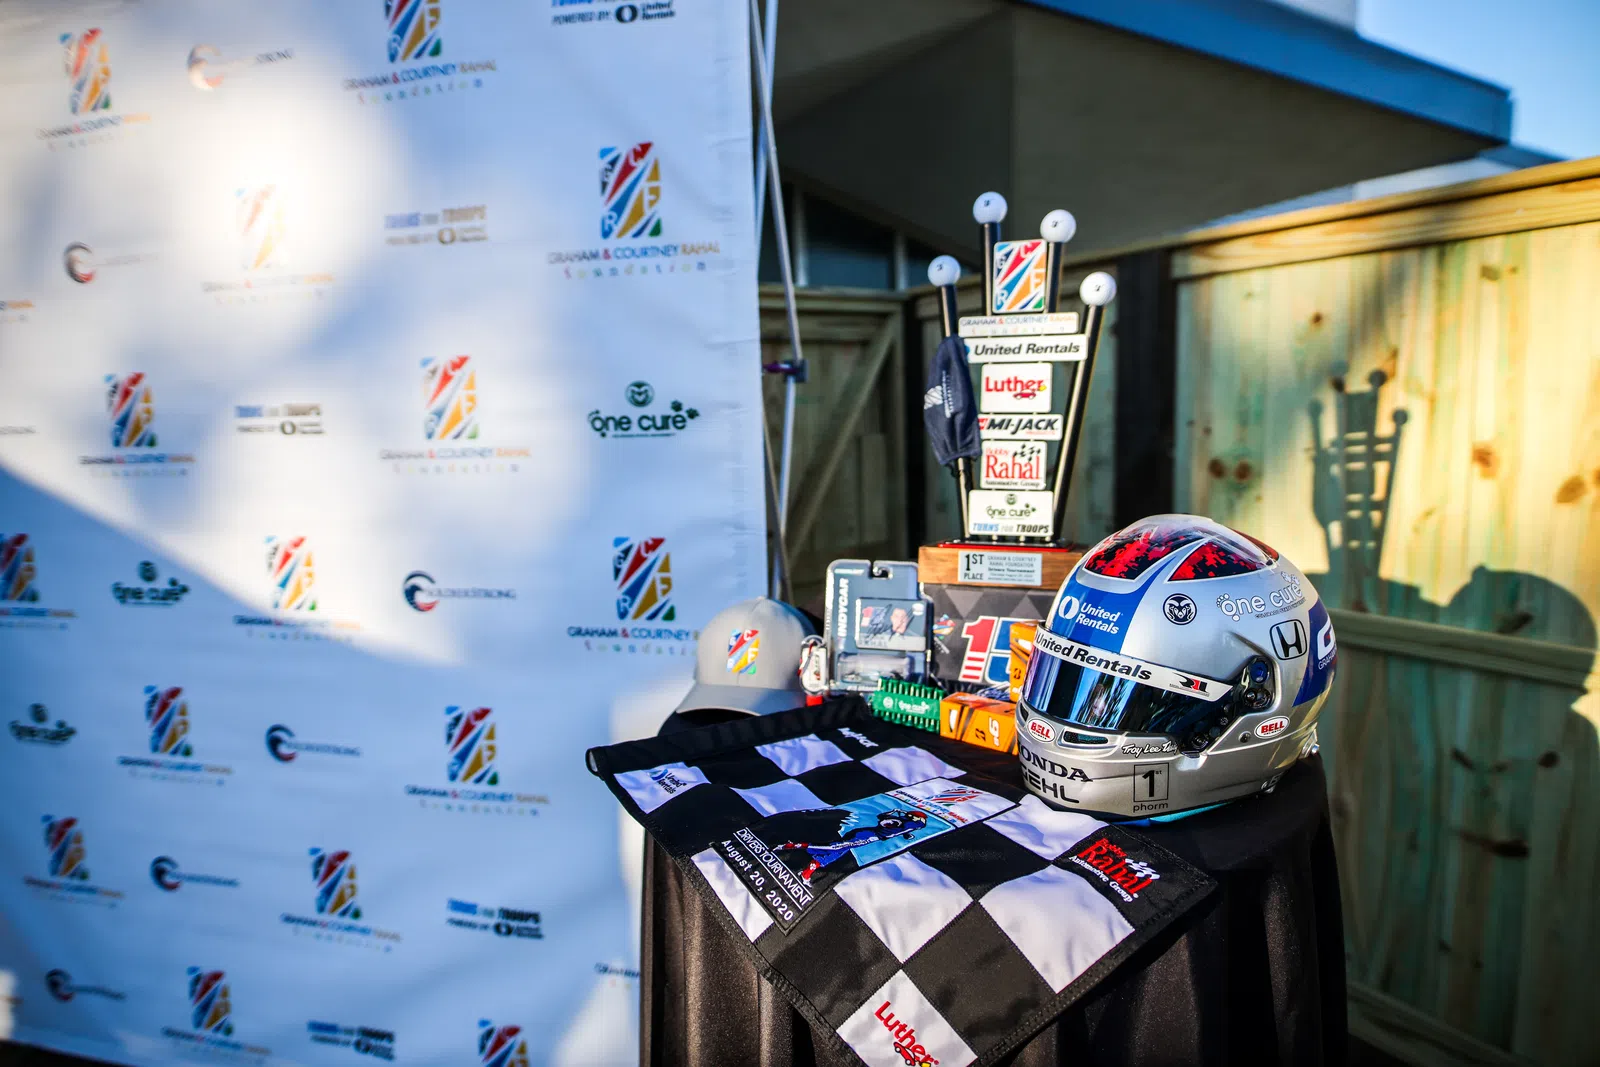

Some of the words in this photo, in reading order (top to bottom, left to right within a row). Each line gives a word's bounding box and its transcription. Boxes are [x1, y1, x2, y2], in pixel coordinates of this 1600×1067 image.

[400, 63, 456, 82] COURTNEY
[613, 243, 679, 260] COURTNEY
[960, 318, 997, 327] GRAHAM
[1006, 315, 1048, 325] COURTNEY
[974, 342, 1022, 356] United
[1026, 341, 1080, 354] Rentals
[985, 376, 1044, 392] Luther
[590, 411, 632, 434] one
[637, 414, 688, 432] cure
[987, 418, 1059, 435] MI-JACK
[985, 454, 1041, 479] Rahal
[986, 506, 1006, 519] one
[1009, 508, 1032, 517] cure
[972, 522, 1000, 532] TURNS
[1016, 523, 1050, 534] TROOPS
[965, 553, 985, 571] 1ST
[963, 572, 984, 580] PLACE
[837, 577, 849, 637] INDYCAR
[1218, 594, 1266, 621] one
[1268, 582, 1303, 608] cure
[1080, 602, 1121, 622] United
[566, 625, 619, 638] GRAHAM
[630, 627, 690, 641] COURTNEY
[1076, 614, 1120, 635] Rentals
[1036, 633, 1075, 658] United
[1073, 649, 1153, 681] Rentals
[1030, 721, 1050, 739] BELL
[1261, 721, 1285, 734] BELL
[1122, 744, 1143, 758] Troy
[1143, 743, 1162, 754] Lee
[1019, 744, 1094, 783] ONDA
[1132, 802, 1169, 813] phorm
[736, 828, 766, 854] DRIVERS
[760, 850, 812, 906] TOURNAMENT
[1077, 839, 1154, 895] Rahal
[721, 840, 753, 872] August
[749, 871, 765, 892] 20,
[765, 890, 794, 921] 2020
[1068, 855, 1110, 883] Automotive
[1109, 881, 1134, 903] Group
[874, 1000, 935, 1066] Luther
